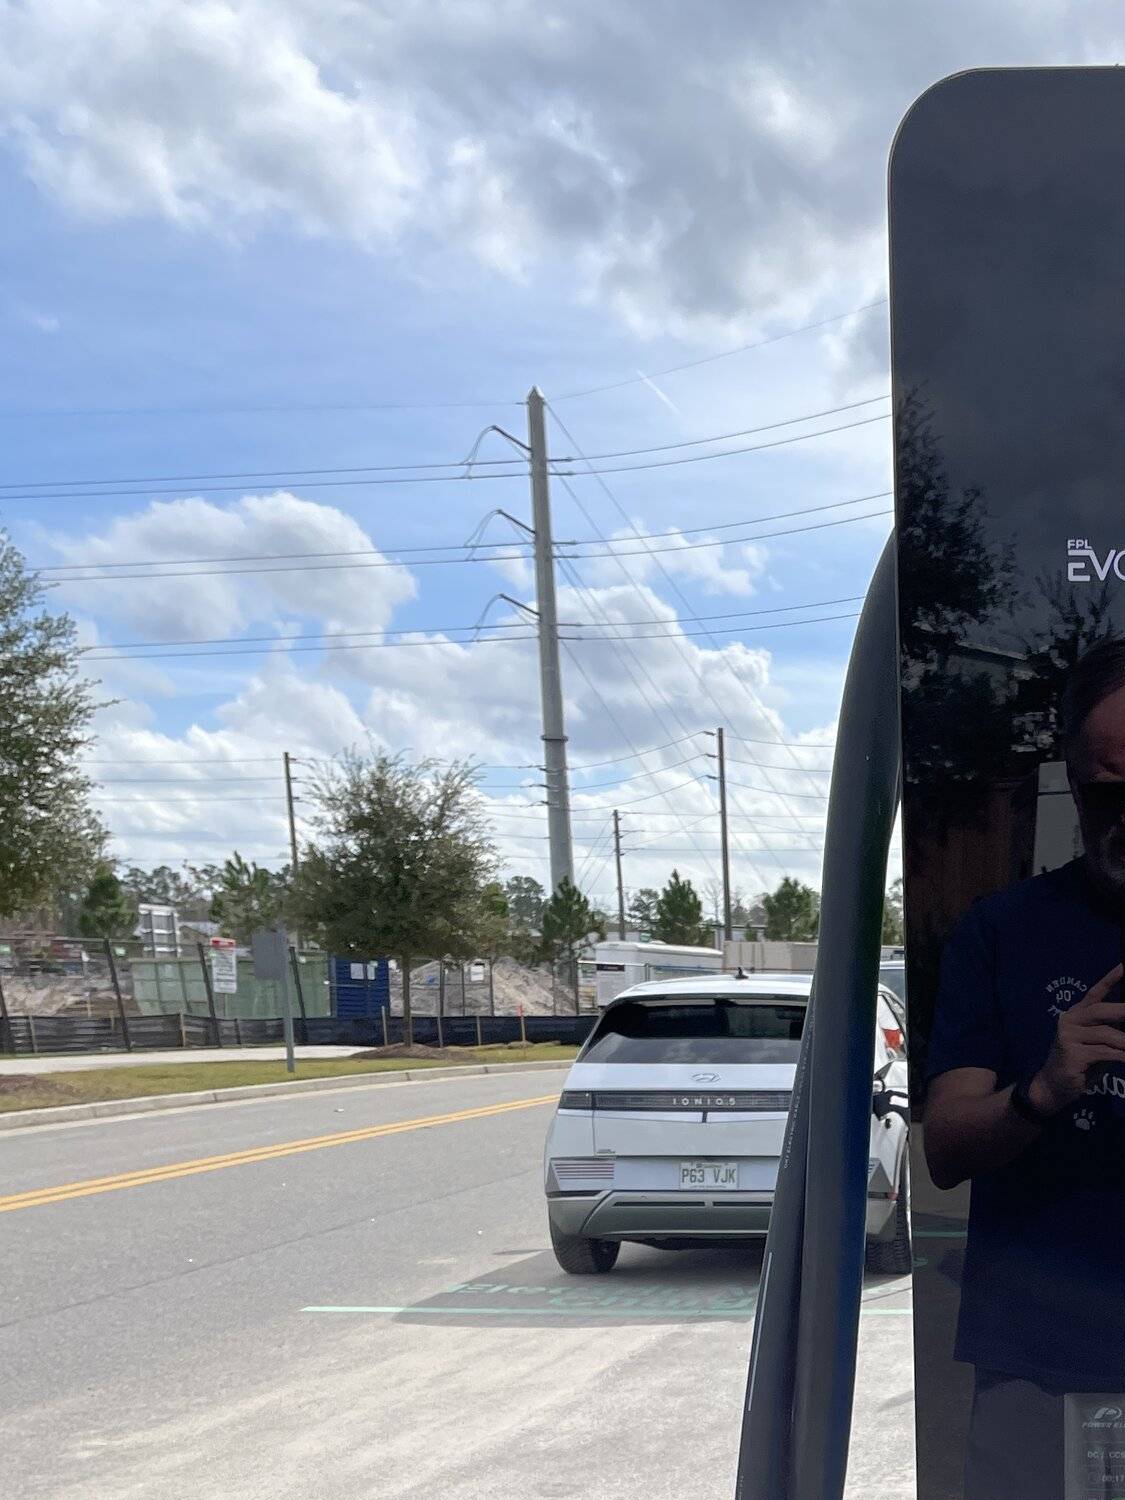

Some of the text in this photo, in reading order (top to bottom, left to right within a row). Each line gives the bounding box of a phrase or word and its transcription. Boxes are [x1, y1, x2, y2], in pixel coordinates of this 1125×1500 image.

[1067, 539, 1092, 549] FPL
[681, 1167, 737, 1184] P63 VJK
